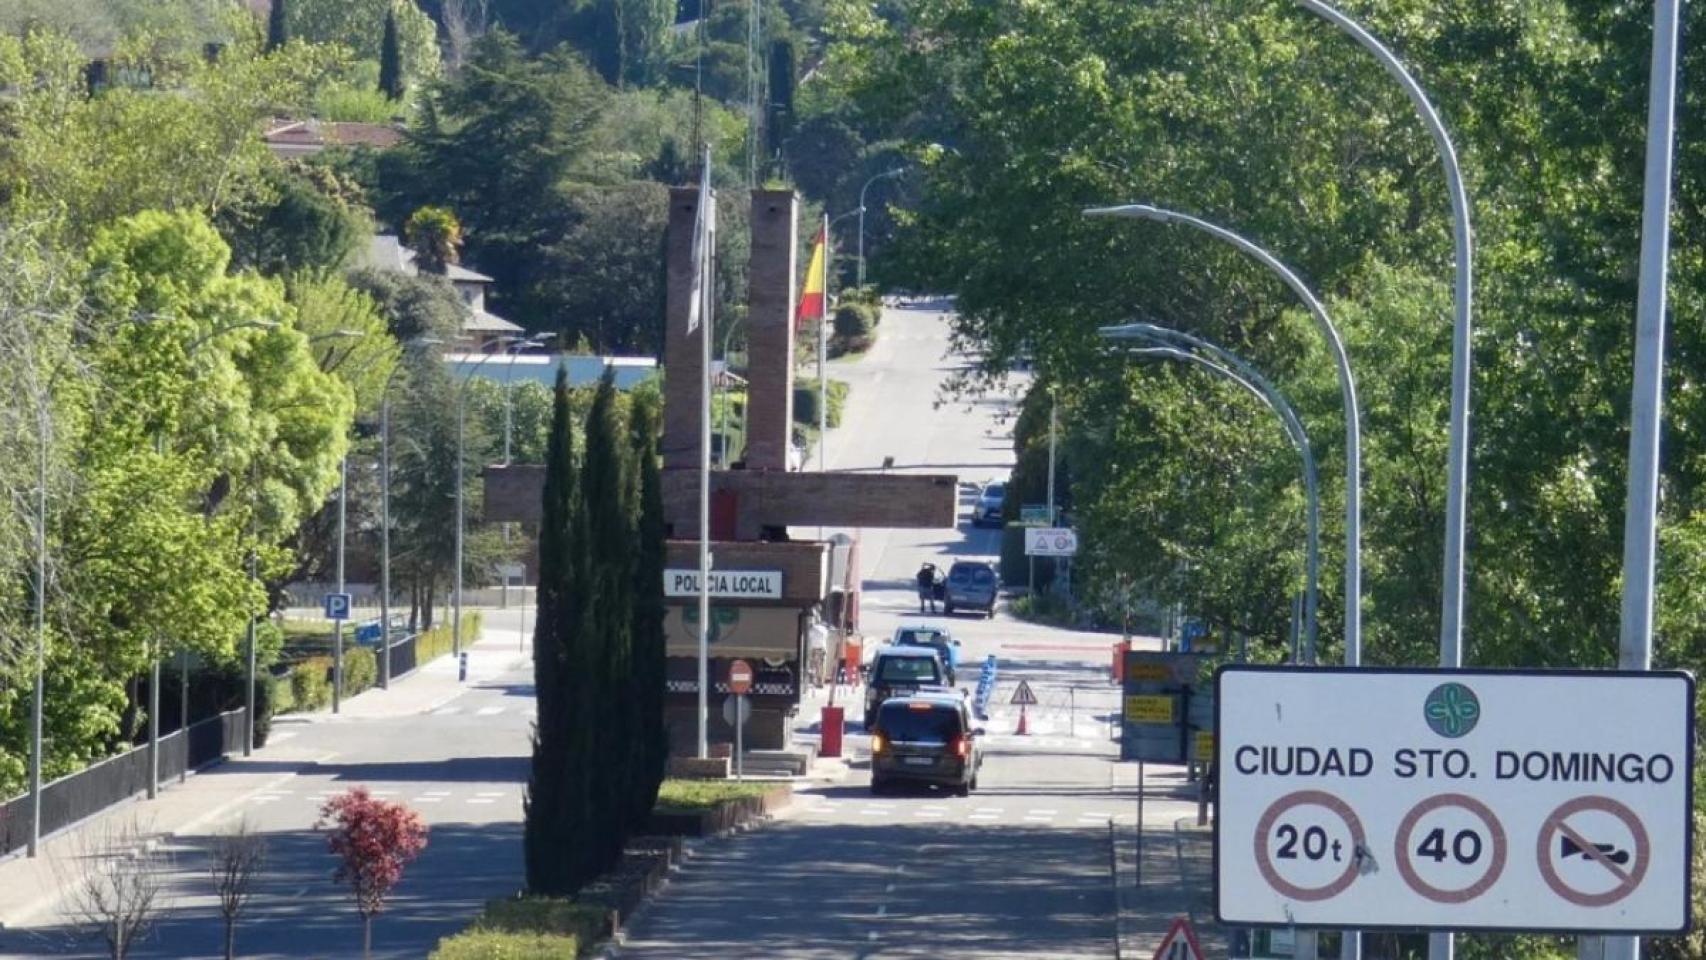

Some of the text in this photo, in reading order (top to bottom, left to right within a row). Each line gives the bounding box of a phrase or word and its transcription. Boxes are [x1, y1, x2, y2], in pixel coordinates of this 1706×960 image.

[674, 575, 772, 593] POLCIA LOCAL
[330, 597, 345, 616] P
[1235, 746, 1674, 784] CIUDAD STO. DOMINGO
[1417, 828, 1482, 865] 40
